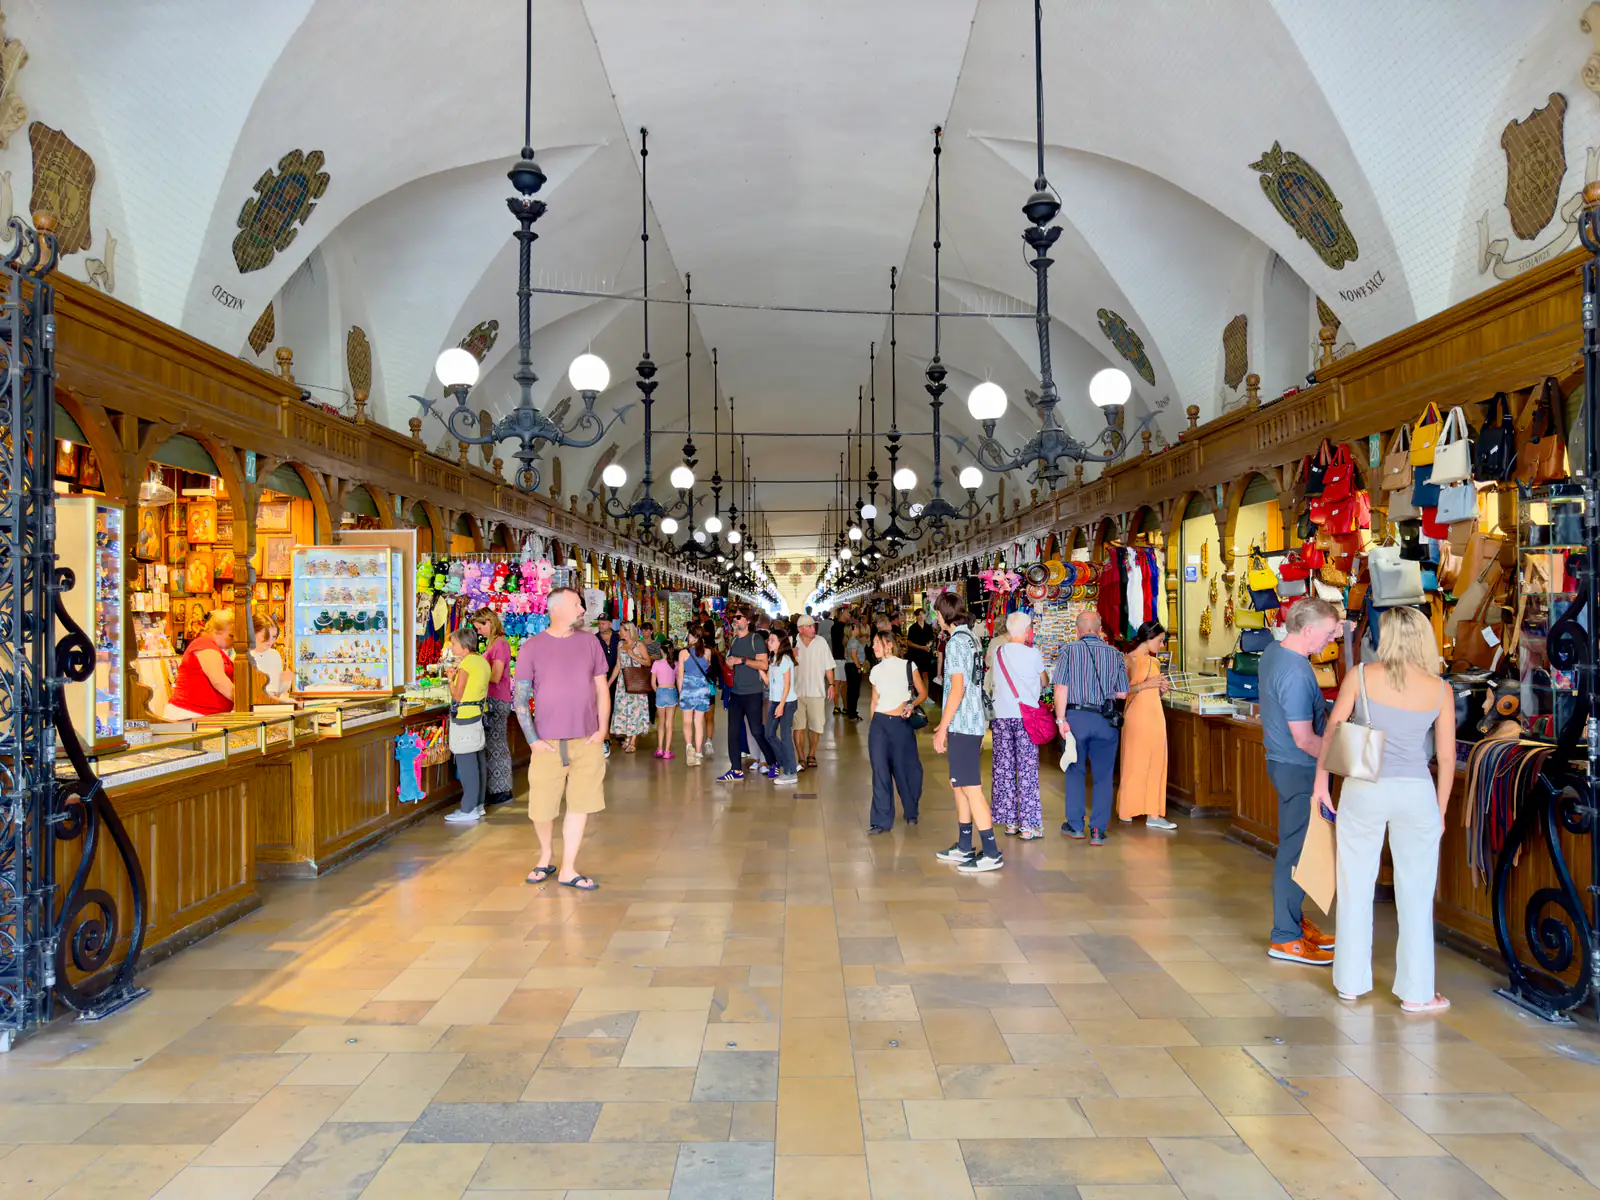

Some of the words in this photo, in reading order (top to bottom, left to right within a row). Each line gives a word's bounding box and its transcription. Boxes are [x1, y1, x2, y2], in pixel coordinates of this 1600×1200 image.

[211, 285, 246, 310] CIESZYN
[1369, 440, 1380, 462] 28
[246, 456, 257, 477] 27
